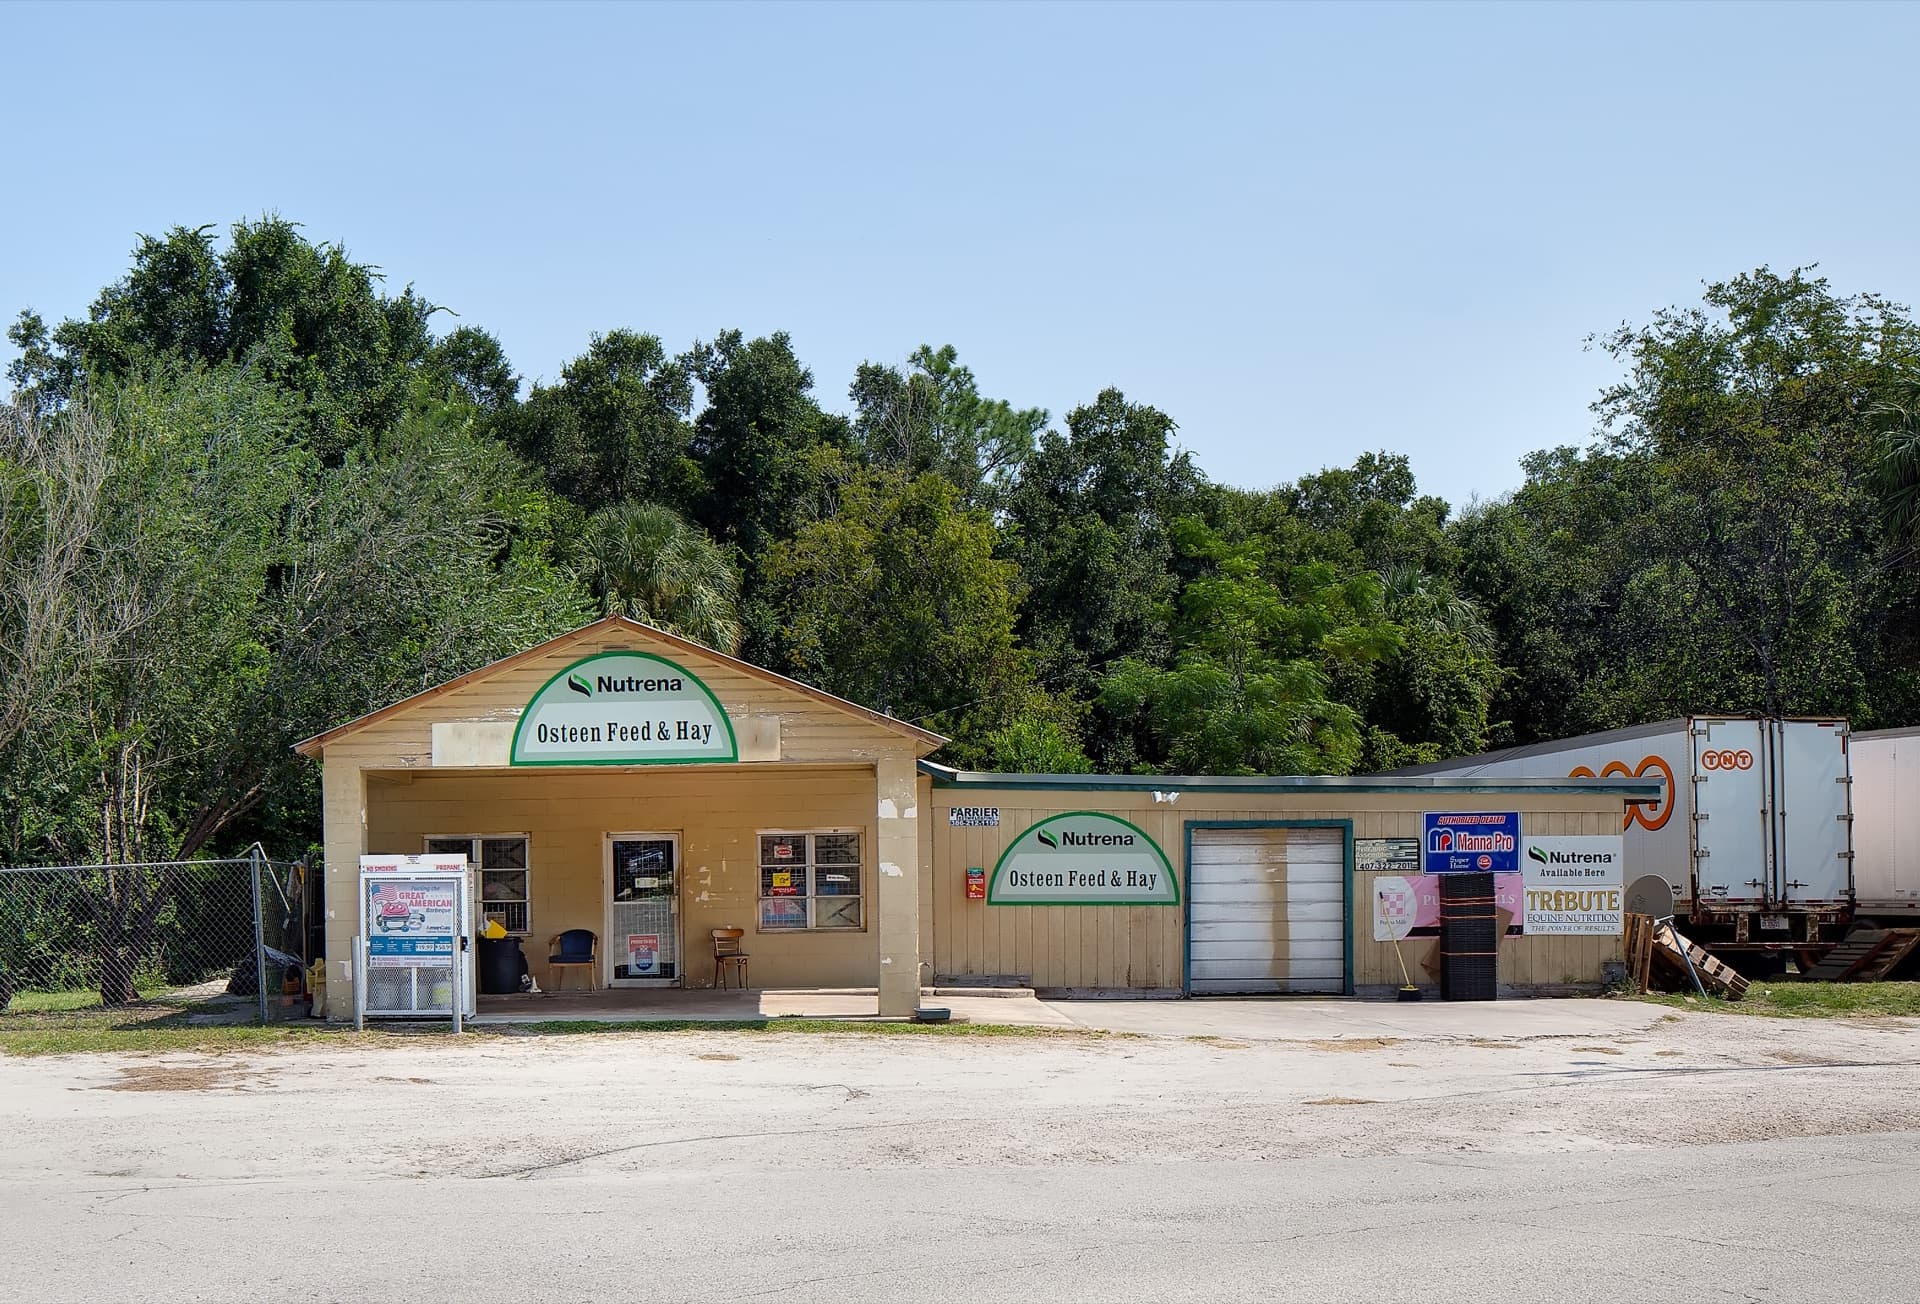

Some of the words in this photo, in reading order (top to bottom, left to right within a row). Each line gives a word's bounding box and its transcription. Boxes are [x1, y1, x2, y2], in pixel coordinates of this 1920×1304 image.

[597, 675, 683, 693] Nutrena
[537, 722, 601, 744] Osteen
[607, 721, 651, 743] Feed
[657, 720, 671, 741] &
[676, 720, 713, 745] Hay
[950, 807, 999, 817] FARRIER
[1437, 815, 1480, 825] AUTHORIZED
[1479, 815, 1506, 824] DEALER
[1062, 831, 1134, 846] Nutrena
[1456, 832, 1493, 852] Manna
[1493, 831, 1514, 852] Pro
[1549, 851, 1612, 864] Nutrena
[1540, 868, 1583, 877] Available
[1584, 868, 1606, 877] Here
[1009, 869, 1064, 887] Osteen
[1068, 870, 1105, 887] Feed
[1110, 870, 1122, 887] &
[1126, 870, 1157, 891] Hay
[399, 892, 426, 900] GREAT
[1526, 890, 1620, 912] TRIBUTE
[408, 899, 453, 907] AMERICAN
[1527, 913, 1563, 923] EQUINE
[1565, 913, 1620, 923] NUTRITION
